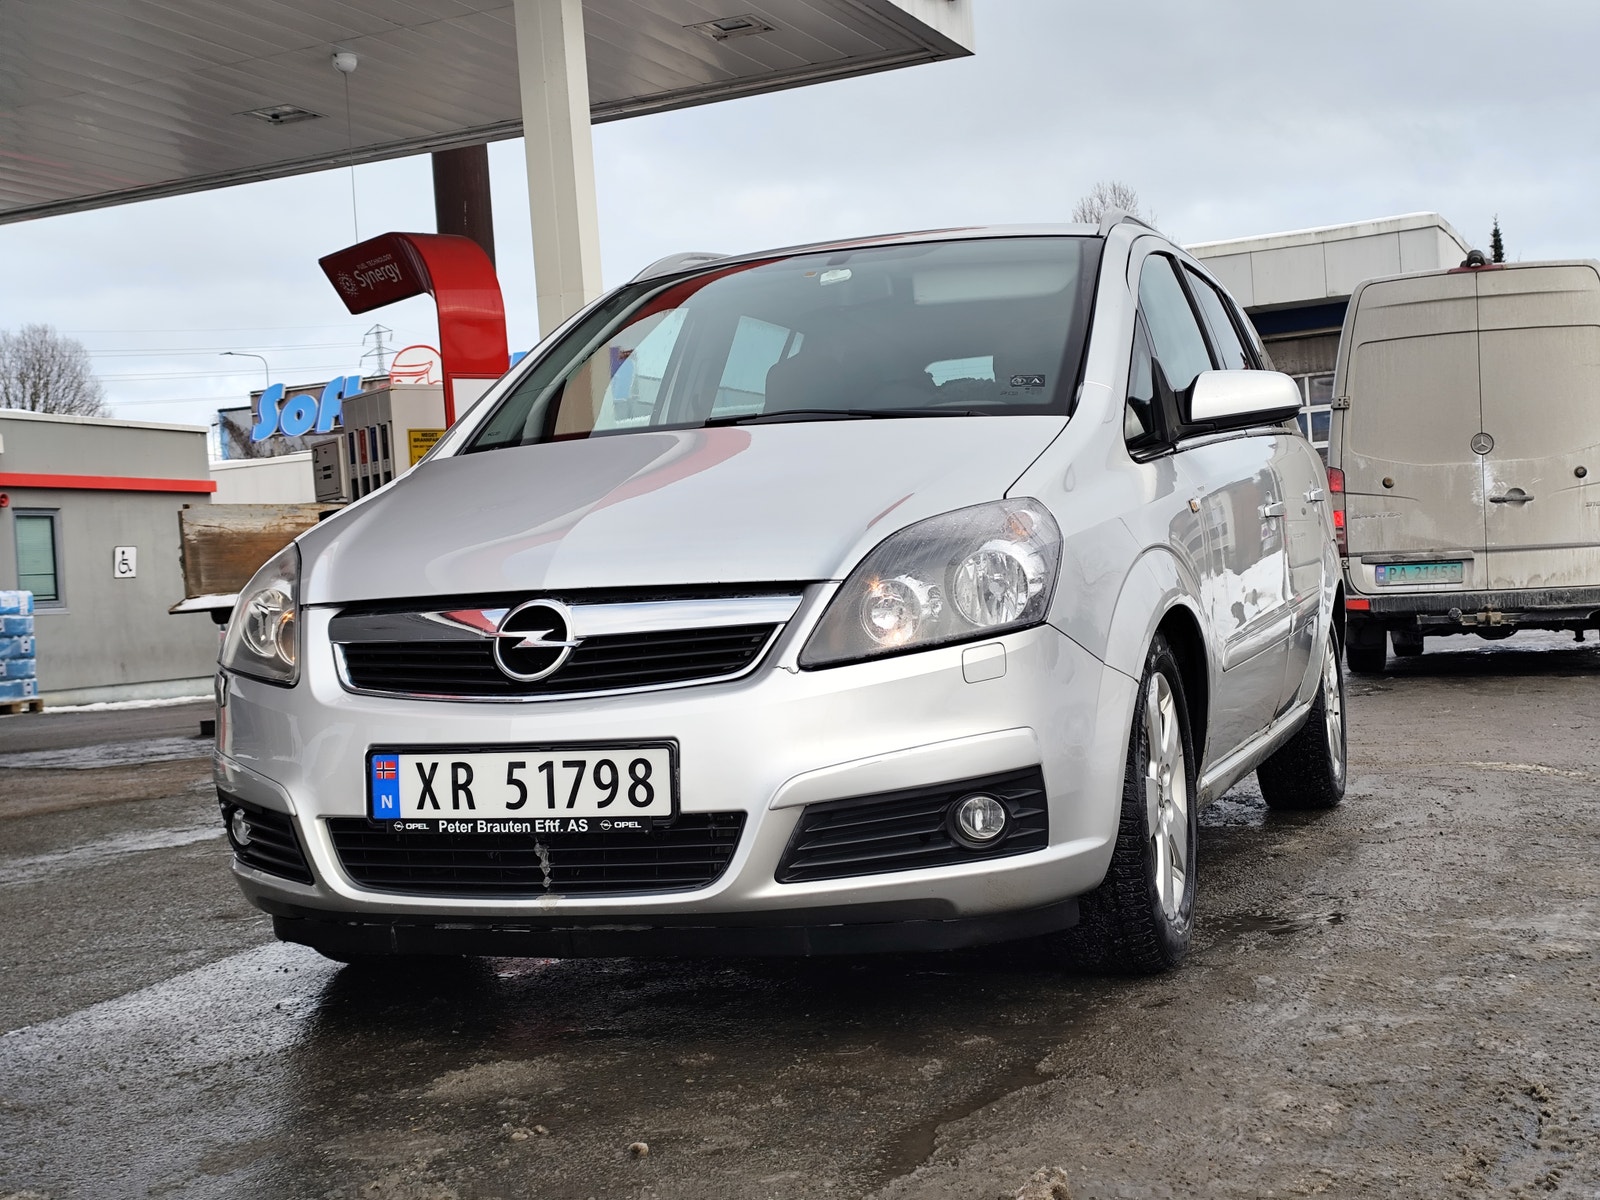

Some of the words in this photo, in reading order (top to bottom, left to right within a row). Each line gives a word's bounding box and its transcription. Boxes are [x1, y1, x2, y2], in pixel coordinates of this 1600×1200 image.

[353, 262, 402, 290] Synergy
[1388, 567, 1407, 581] PA
[1414, 564, 1458, 580] 21455
[415, 761, 477, 811] XR
[505, 757, 655, 811] 51798
[381, 794, 393, 809] N
[438, 819, 474, 833] Peter
[477, 819, 531, 833] Brauten
[535, 819, 564, 832] Eftf.
[567, 818, 589, 832] AS
